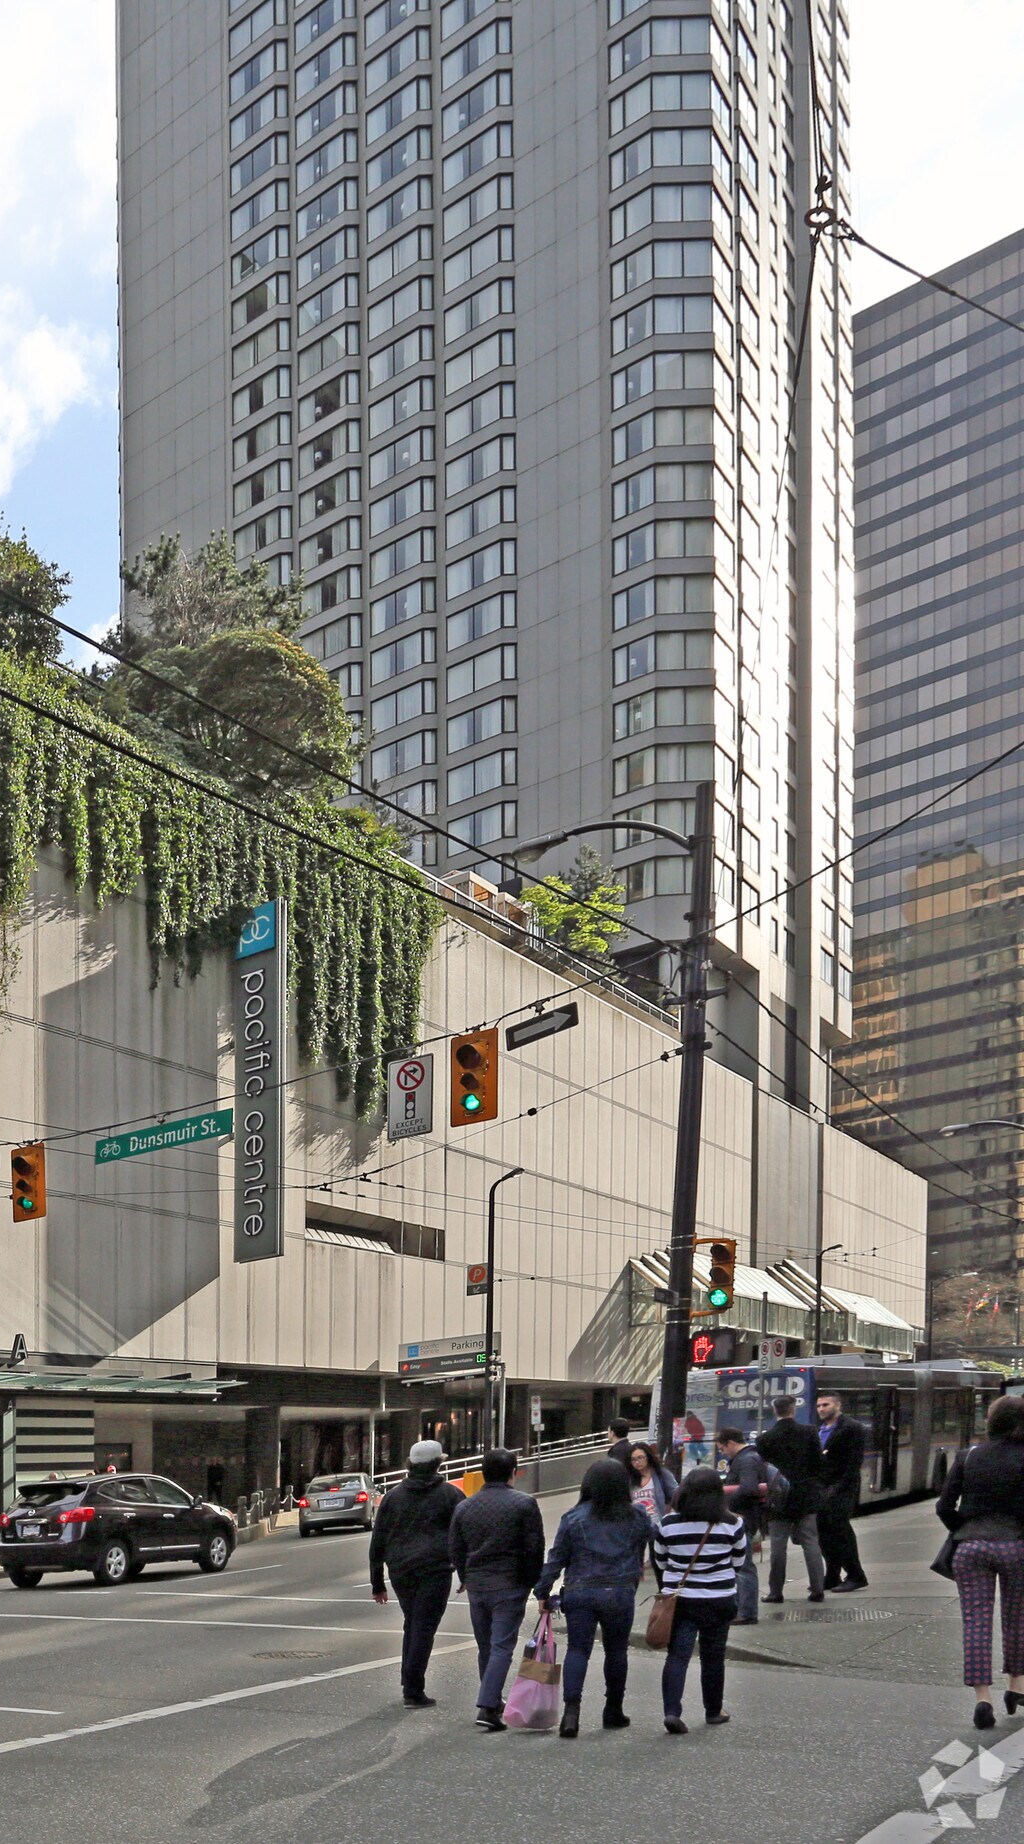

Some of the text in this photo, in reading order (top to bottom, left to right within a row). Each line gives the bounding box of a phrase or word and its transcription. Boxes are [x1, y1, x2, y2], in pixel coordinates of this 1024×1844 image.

[240, 968, 270, 1237] pacific centre
[395, 1117, 424, 1129] EXCEPT
[129, 1118, 222, 1153] Dunsmuir St.
[392, 1124, 427, 1137] BICYCLES
[451, 1339, 484, 1351] Parking
[727, 1376, 805, 1399] GOLD
[727, 1398, 805, 1410] MEDAL GD
